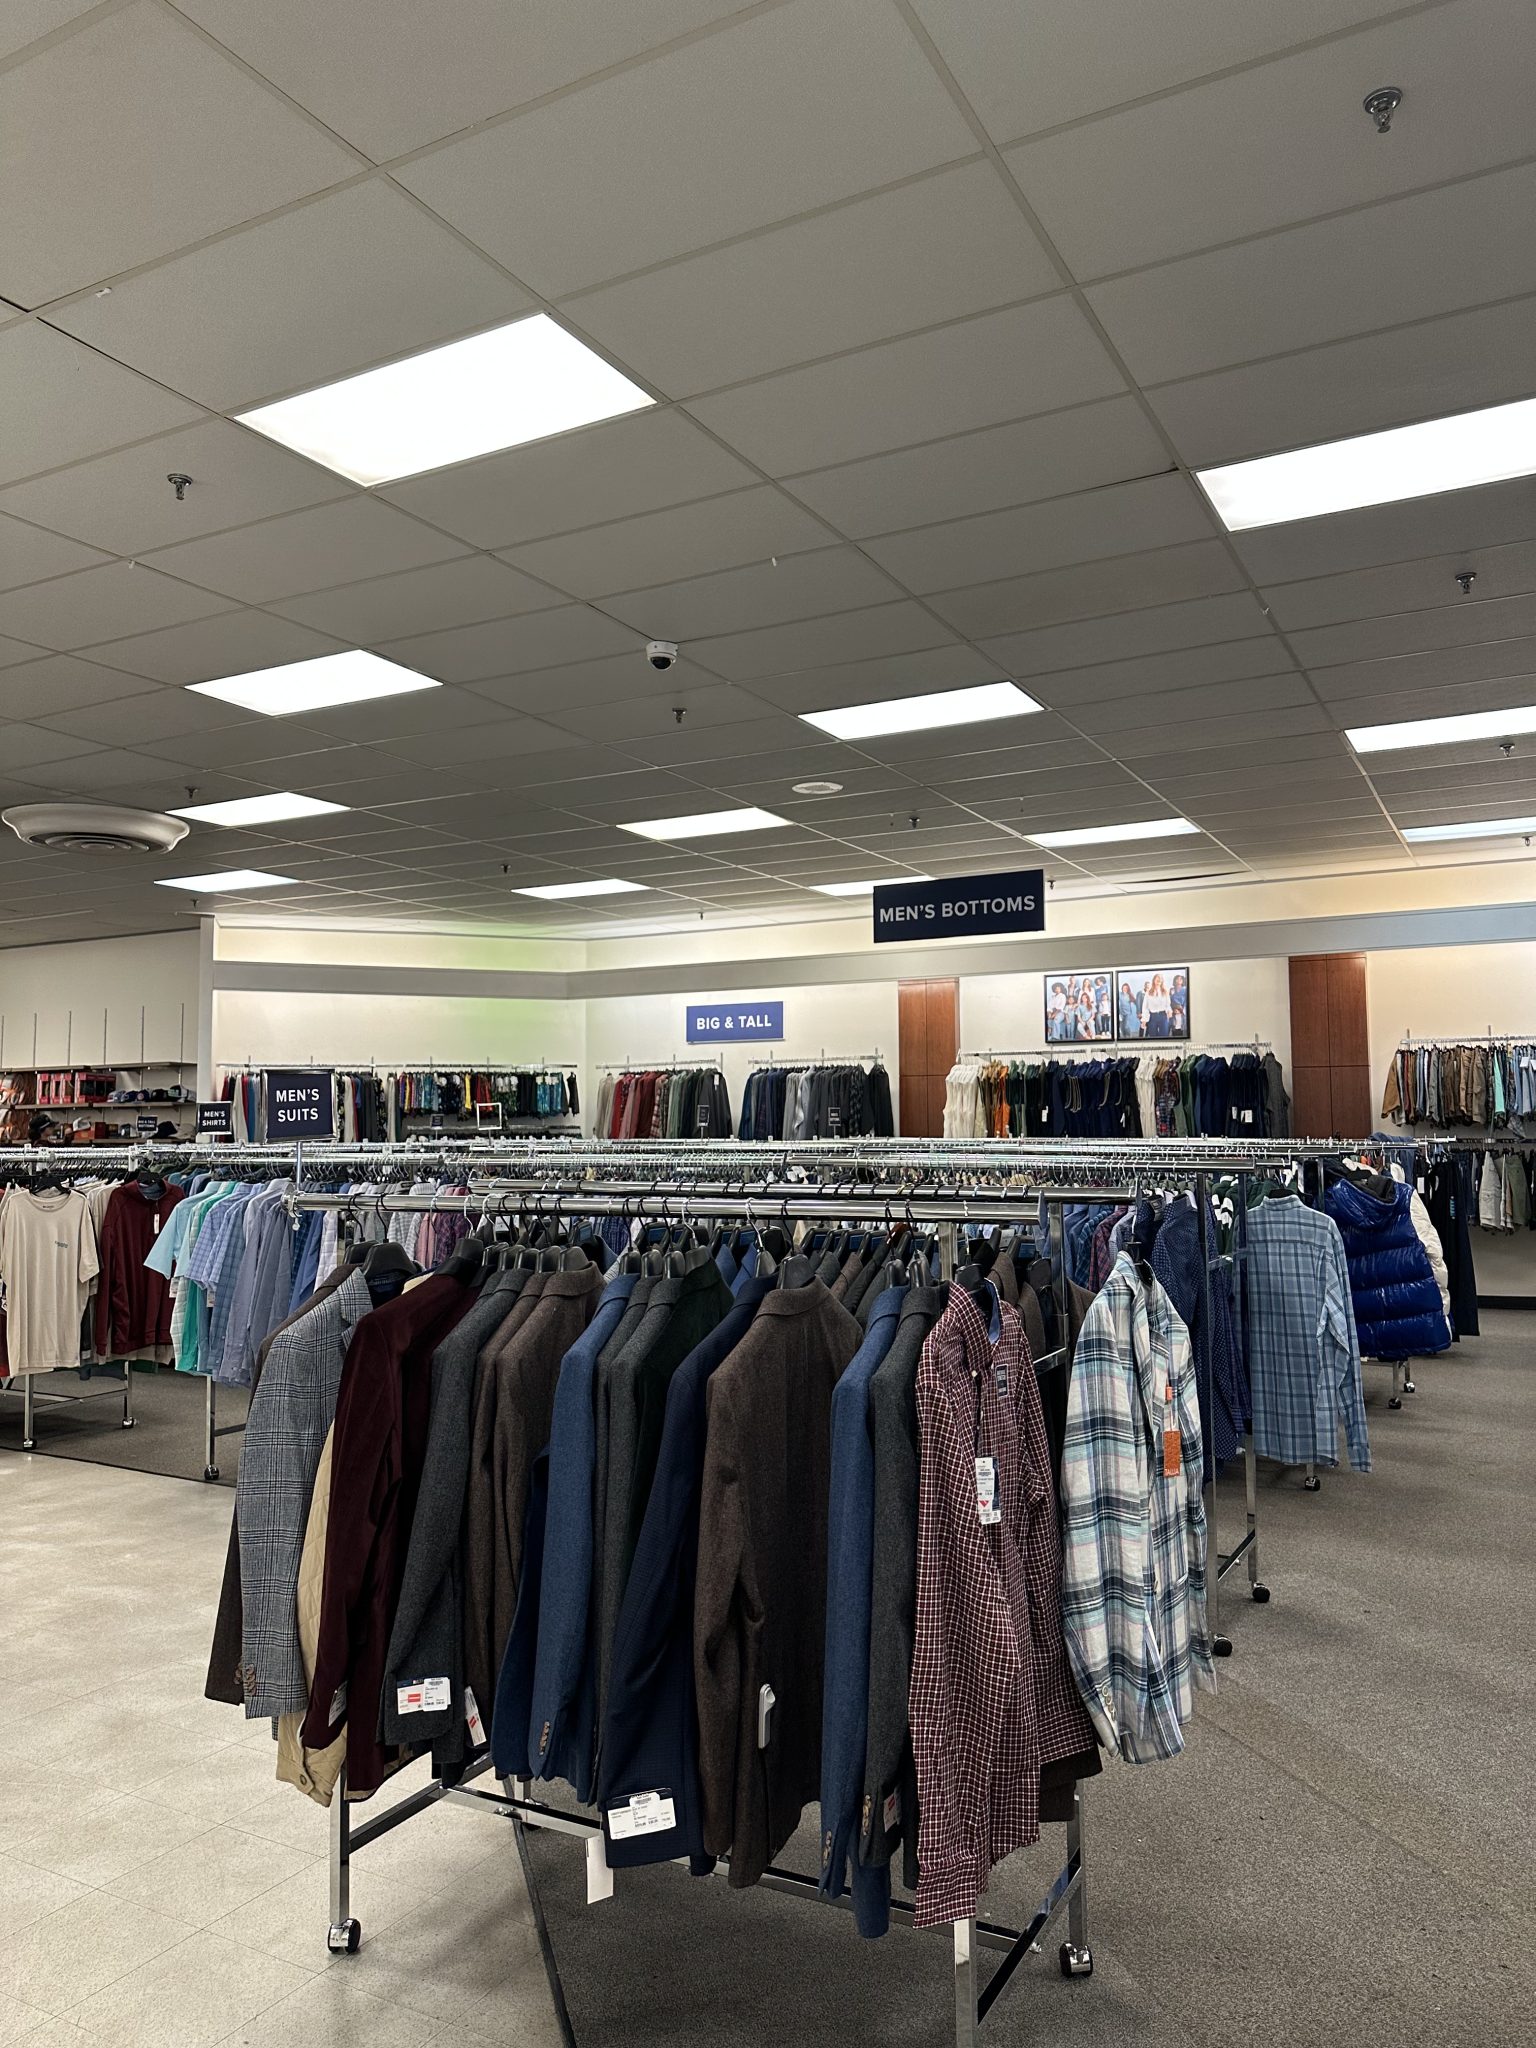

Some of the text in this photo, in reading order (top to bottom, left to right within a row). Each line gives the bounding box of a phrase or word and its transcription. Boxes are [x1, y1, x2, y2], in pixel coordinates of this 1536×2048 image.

[879, 895, 1036, 923] MEN'S BOTTOMS
[696, 1014, 772, 1030] BIG & TALL
[275, 1088, 320, 1103] MEN'S
[203, 1110, 226, 1118] MEN'S
[277, 1107, 319, 1123] SUITS
[202, 1119, 226, 1127] SHIRTS
